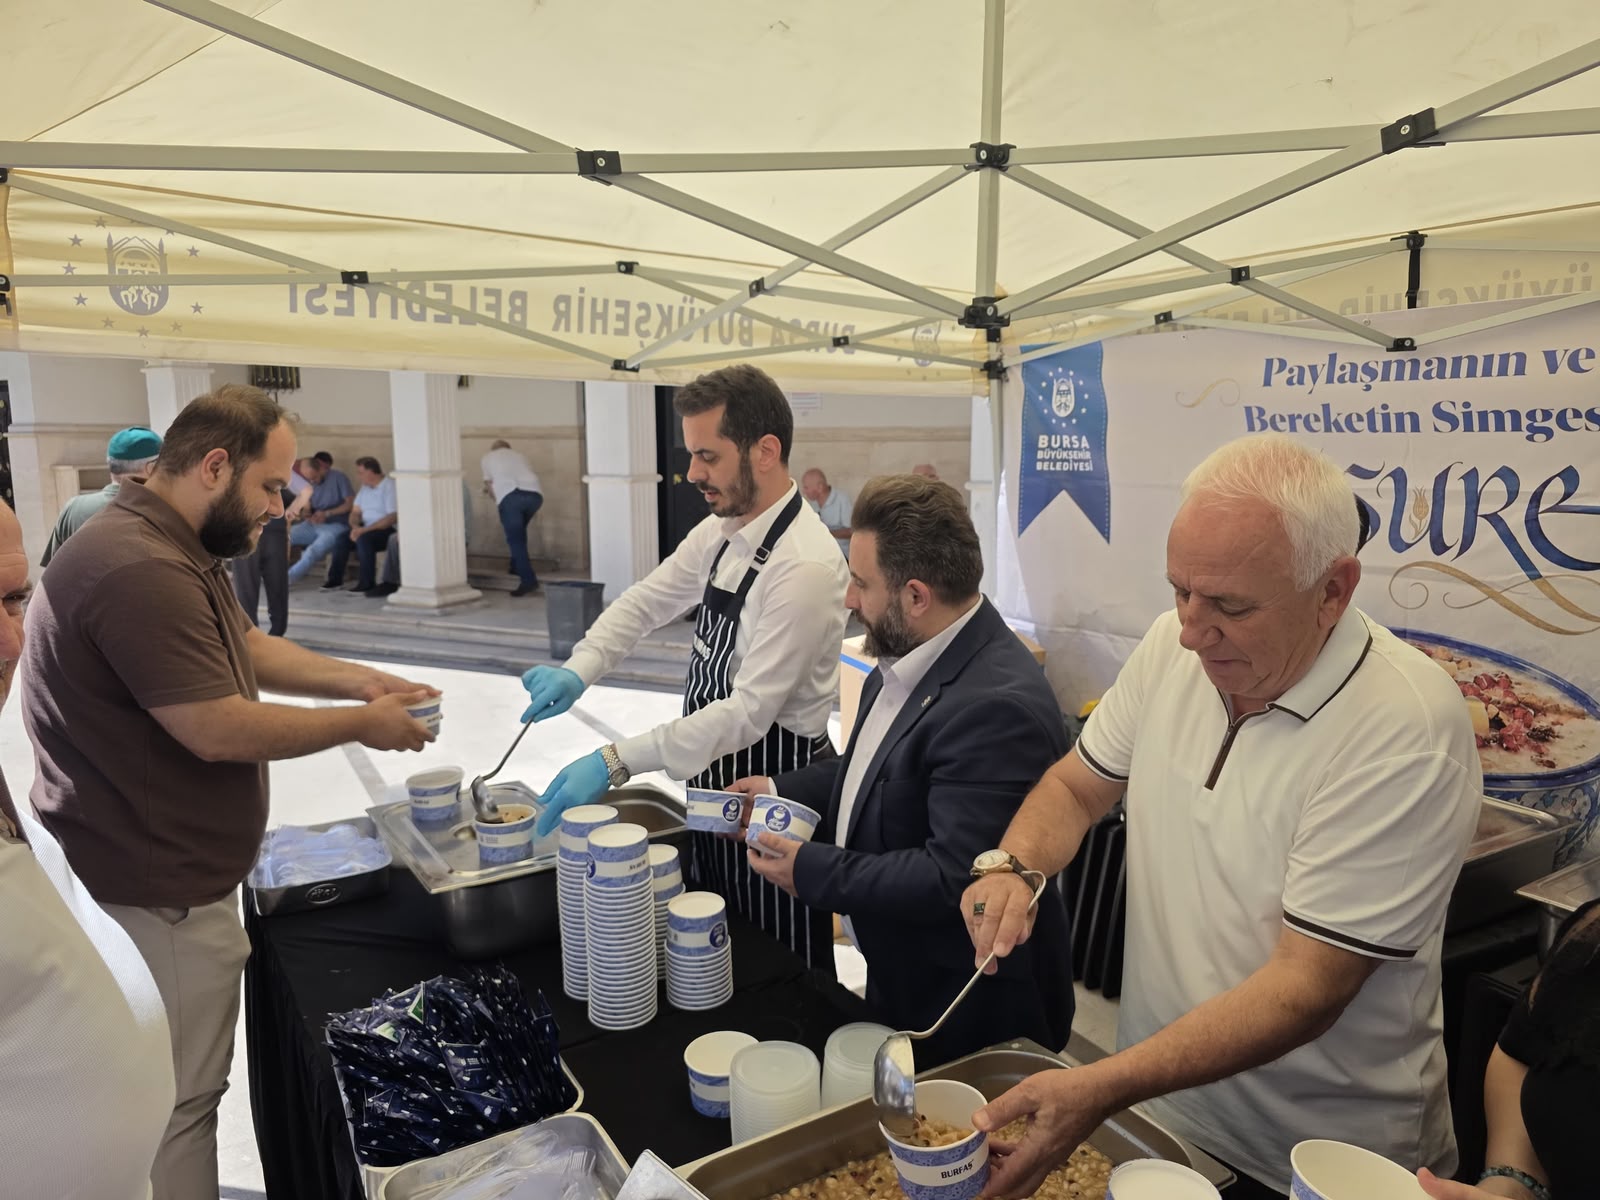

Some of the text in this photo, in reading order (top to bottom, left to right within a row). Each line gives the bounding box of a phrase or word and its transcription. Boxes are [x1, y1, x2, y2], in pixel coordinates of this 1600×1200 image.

[1262, 346, 1596, 394] Paylaşmanın ve
[1038, 434, 1090, 449] BURSA
[1243, 400, 1600, 443] Bereketin Simges
